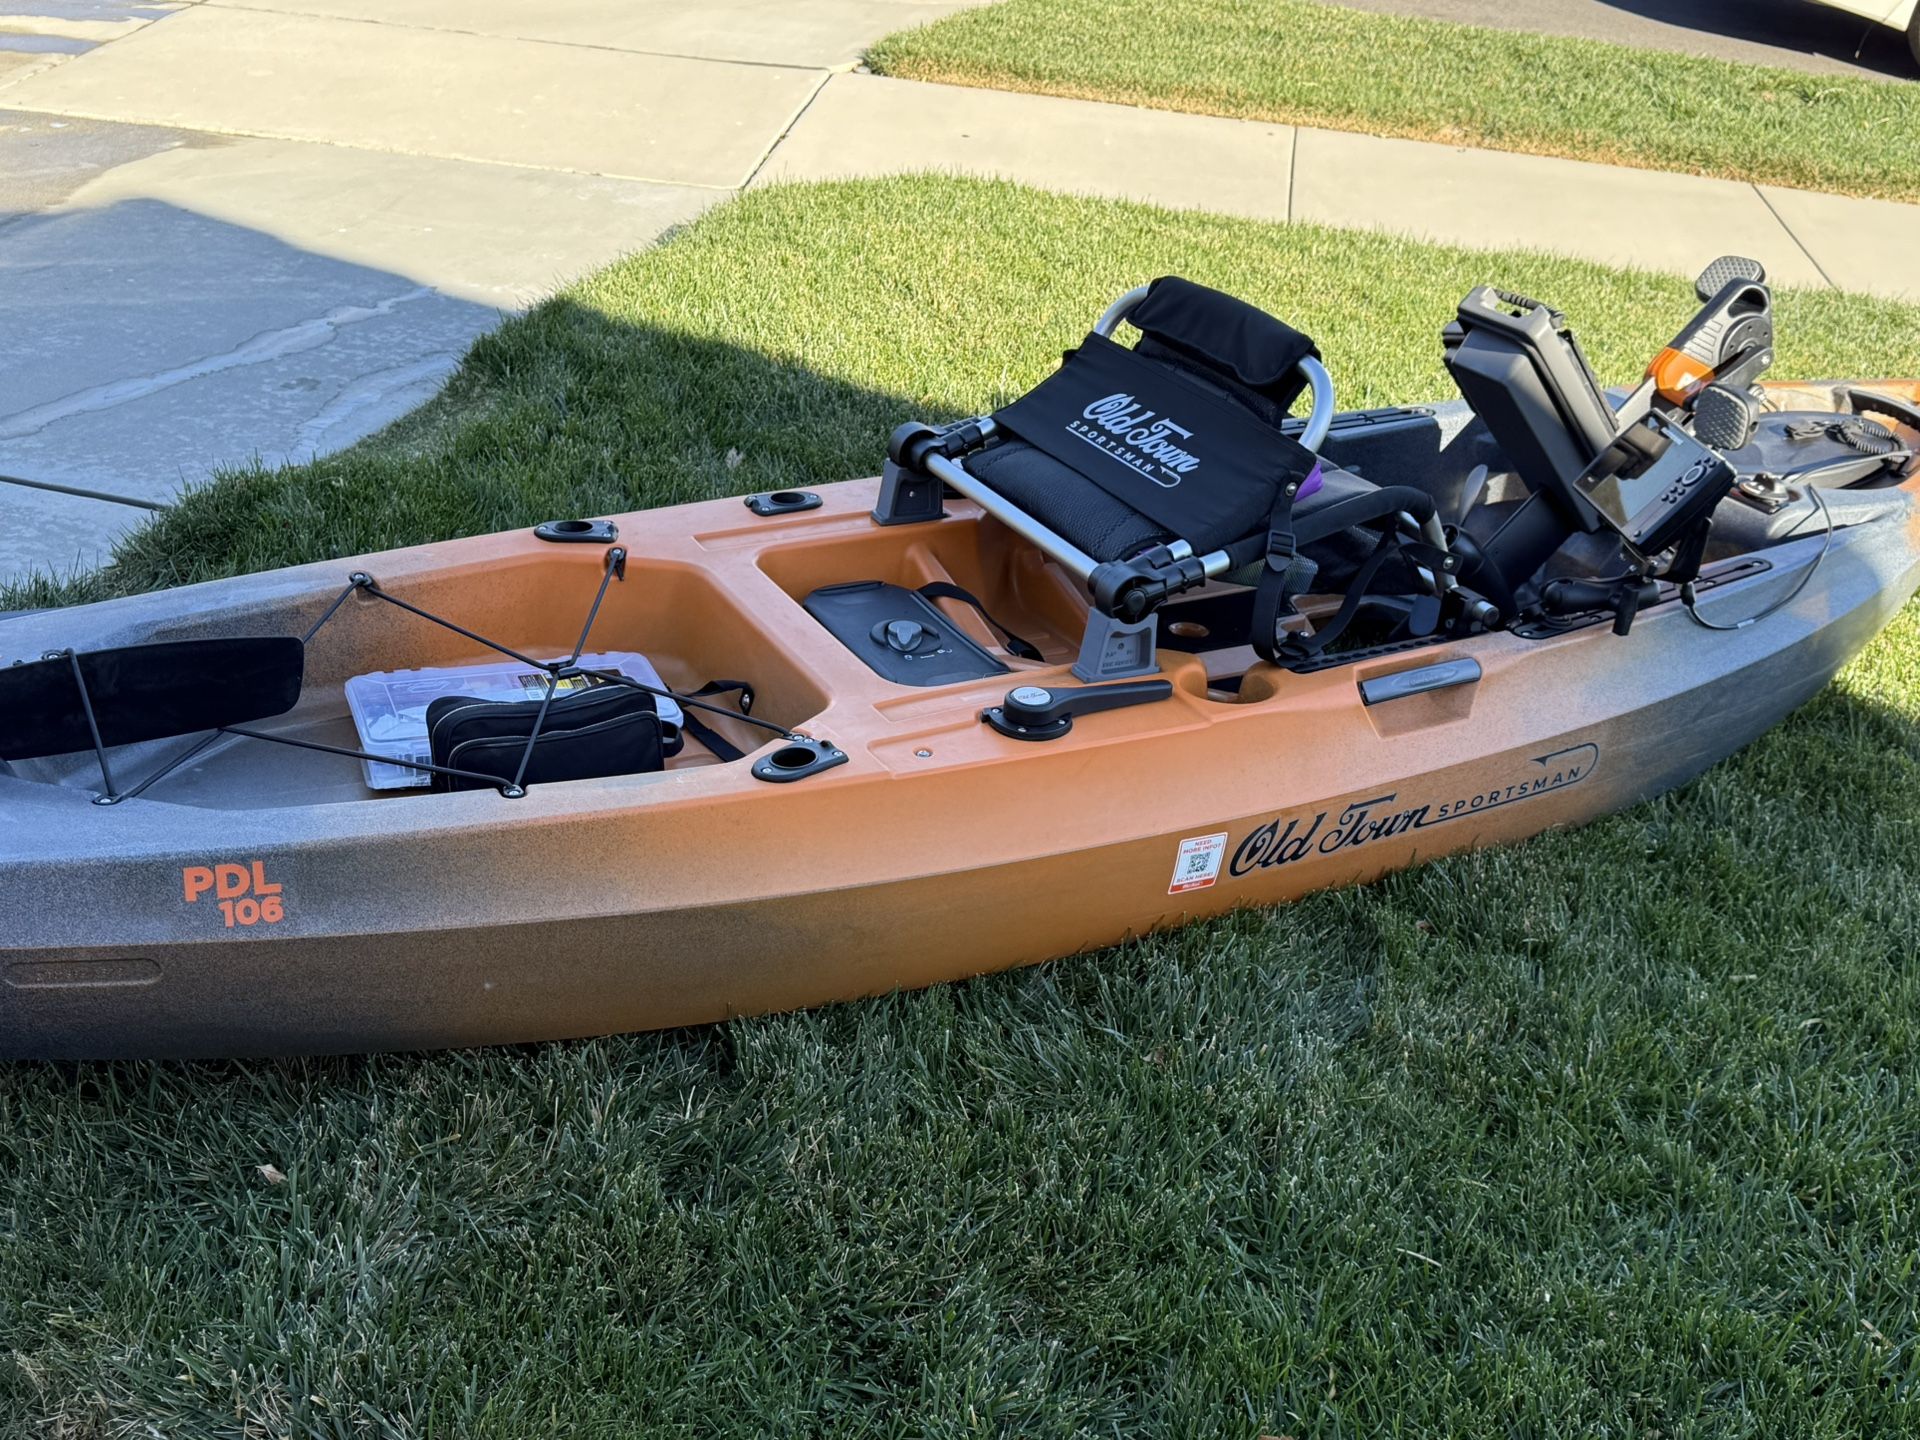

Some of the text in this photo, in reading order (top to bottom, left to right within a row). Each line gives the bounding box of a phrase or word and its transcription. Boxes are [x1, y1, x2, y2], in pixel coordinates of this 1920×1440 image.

[1069, 420, 1155, 472] SPORTSMAN
[1083, 393, 1200, 472] Old Town
[1230, 766, 1581, 877] Old Town SPORTSMAN
[183, 860, 282, 902] PDL
[218, 895, 284, 928] 106
